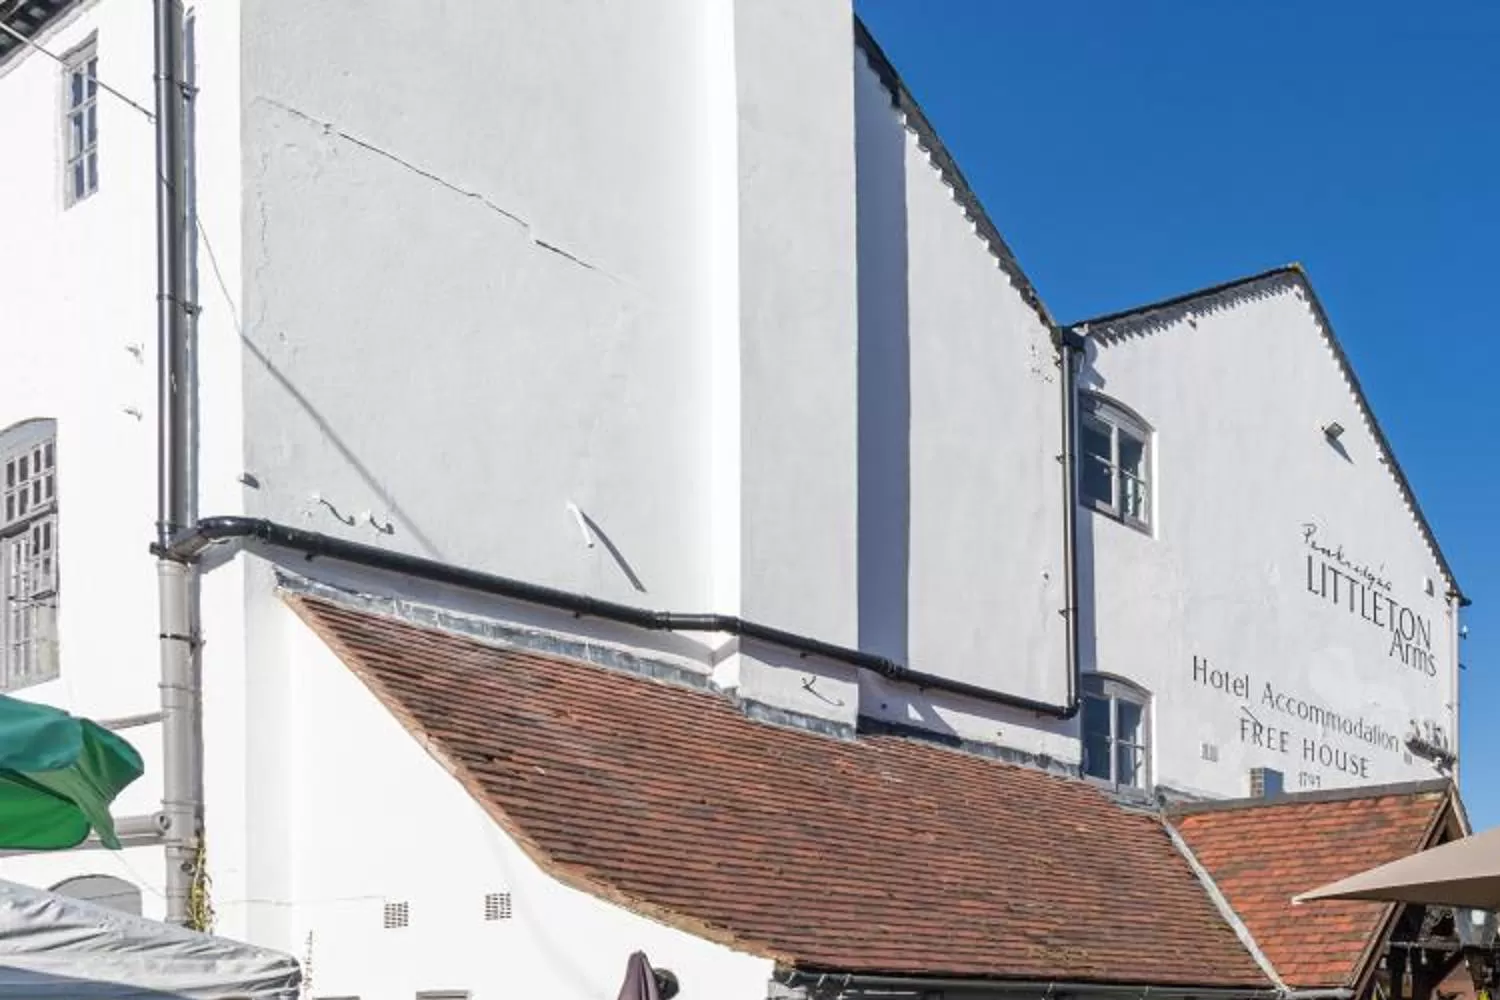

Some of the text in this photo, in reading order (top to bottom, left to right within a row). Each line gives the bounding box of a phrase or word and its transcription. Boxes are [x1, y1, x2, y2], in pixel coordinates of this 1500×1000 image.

[1307, 555, 1432, 649] LITTLETON
[1389, 627, 1437, 678] Arms
[1193, 655, 1399, 753] Hotel Accommodation
[1240, 717, 1370, 778] FREE HOUSE
